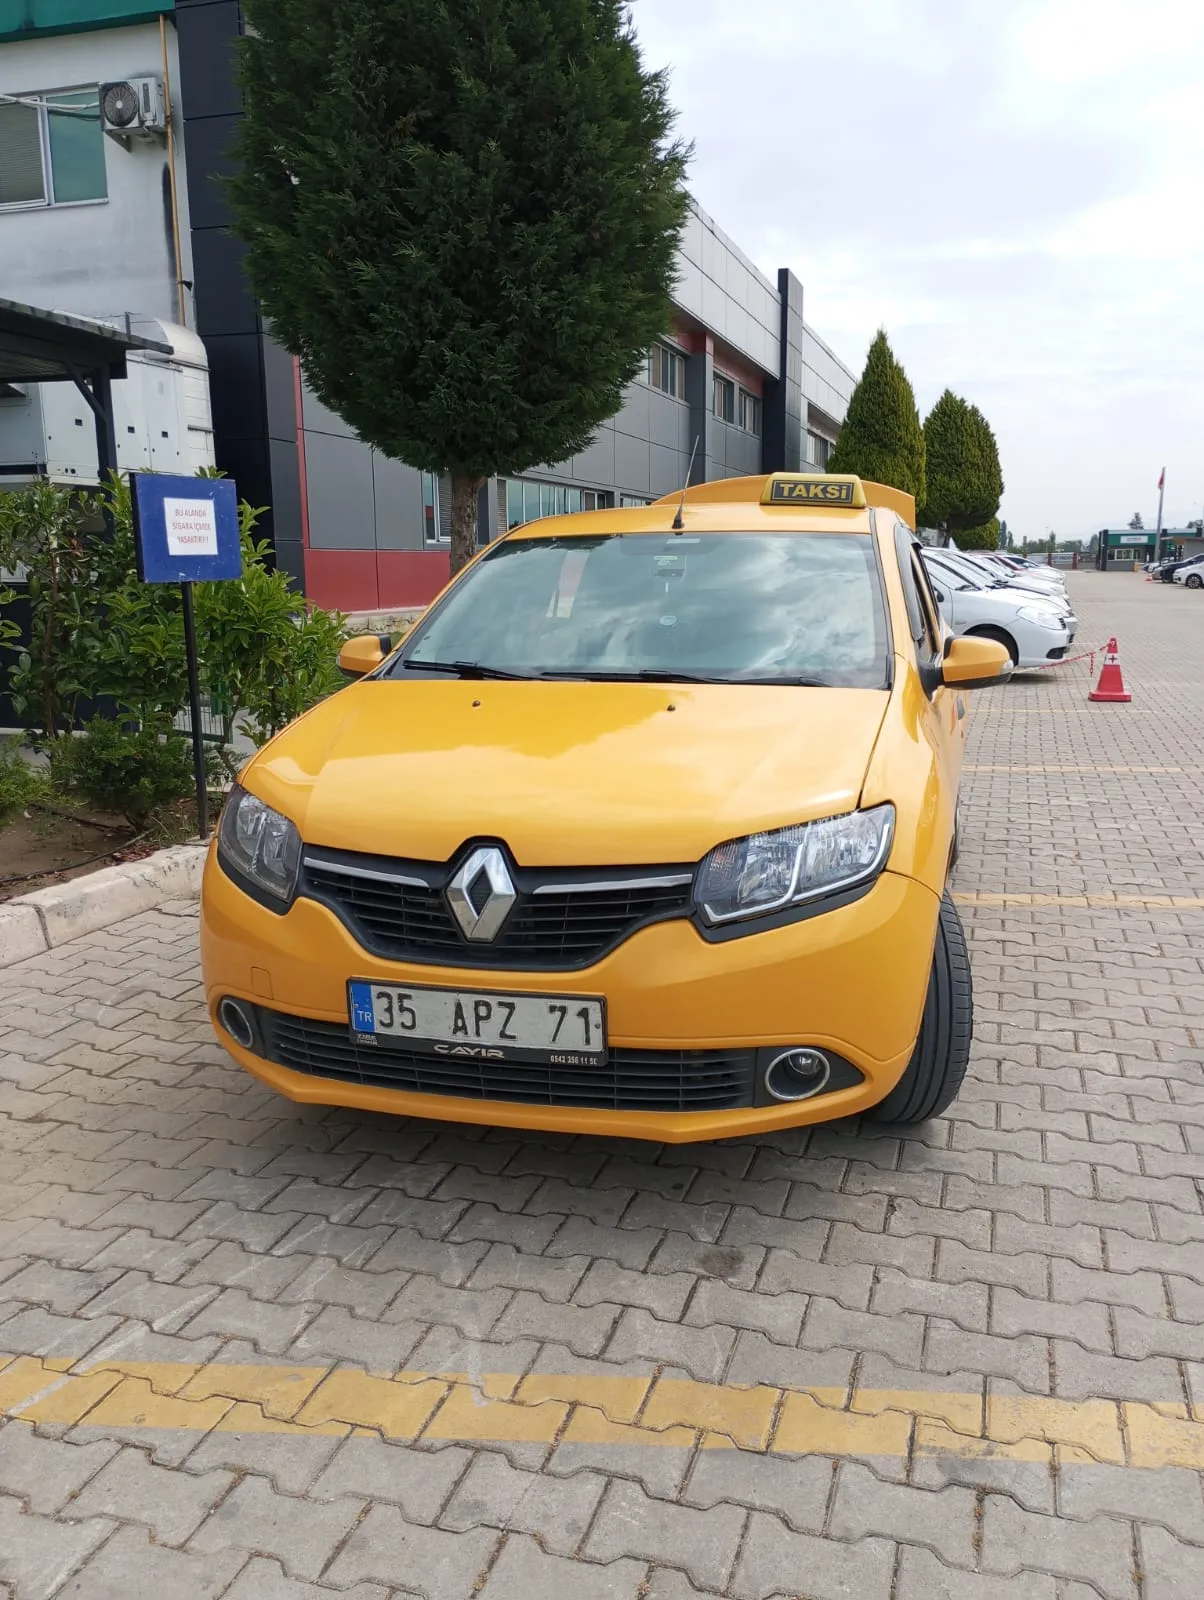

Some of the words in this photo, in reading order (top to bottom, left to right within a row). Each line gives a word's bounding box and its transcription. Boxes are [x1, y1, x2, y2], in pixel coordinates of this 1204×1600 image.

[357, 1010, 372, 1023] TR
[376, 991, 416, 1030] 35
[452, 999, 517, 1039] APZ
[549, 1005, 591, 1045] 71
[433, 1044, 505, 1059] CAYIR
